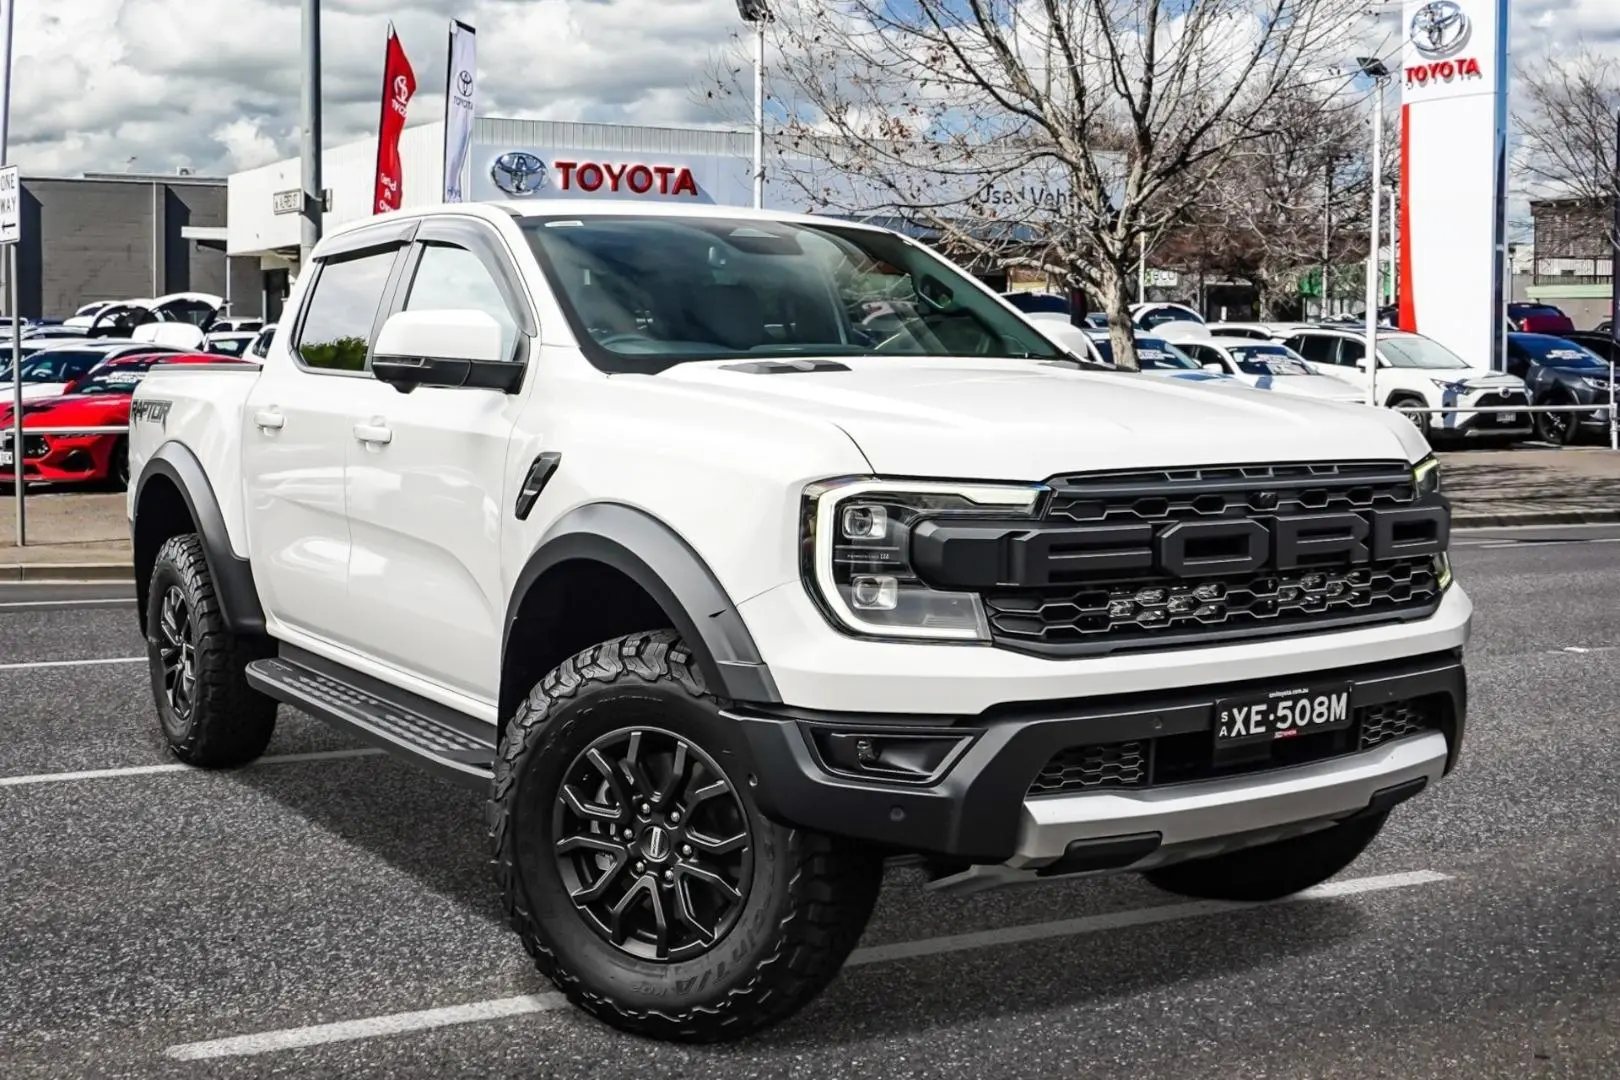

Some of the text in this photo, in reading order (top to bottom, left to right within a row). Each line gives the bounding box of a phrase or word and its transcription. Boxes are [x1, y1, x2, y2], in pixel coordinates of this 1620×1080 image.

[1404, 57, 1481, 84] TOYOTA
[453, 95, 474, 111] TOYOTA
[0, 173, 16, 193] ONE
[555, 161, 698, 197] TOYOTA
[0, 195, 17, 214] WAY
[131, 398, 173, 436] RAPTOR
[1012, 503, 1450, 588] FORD
[1220, 711, 1229, 722] S
[1218, 725, 1228, 738] A
